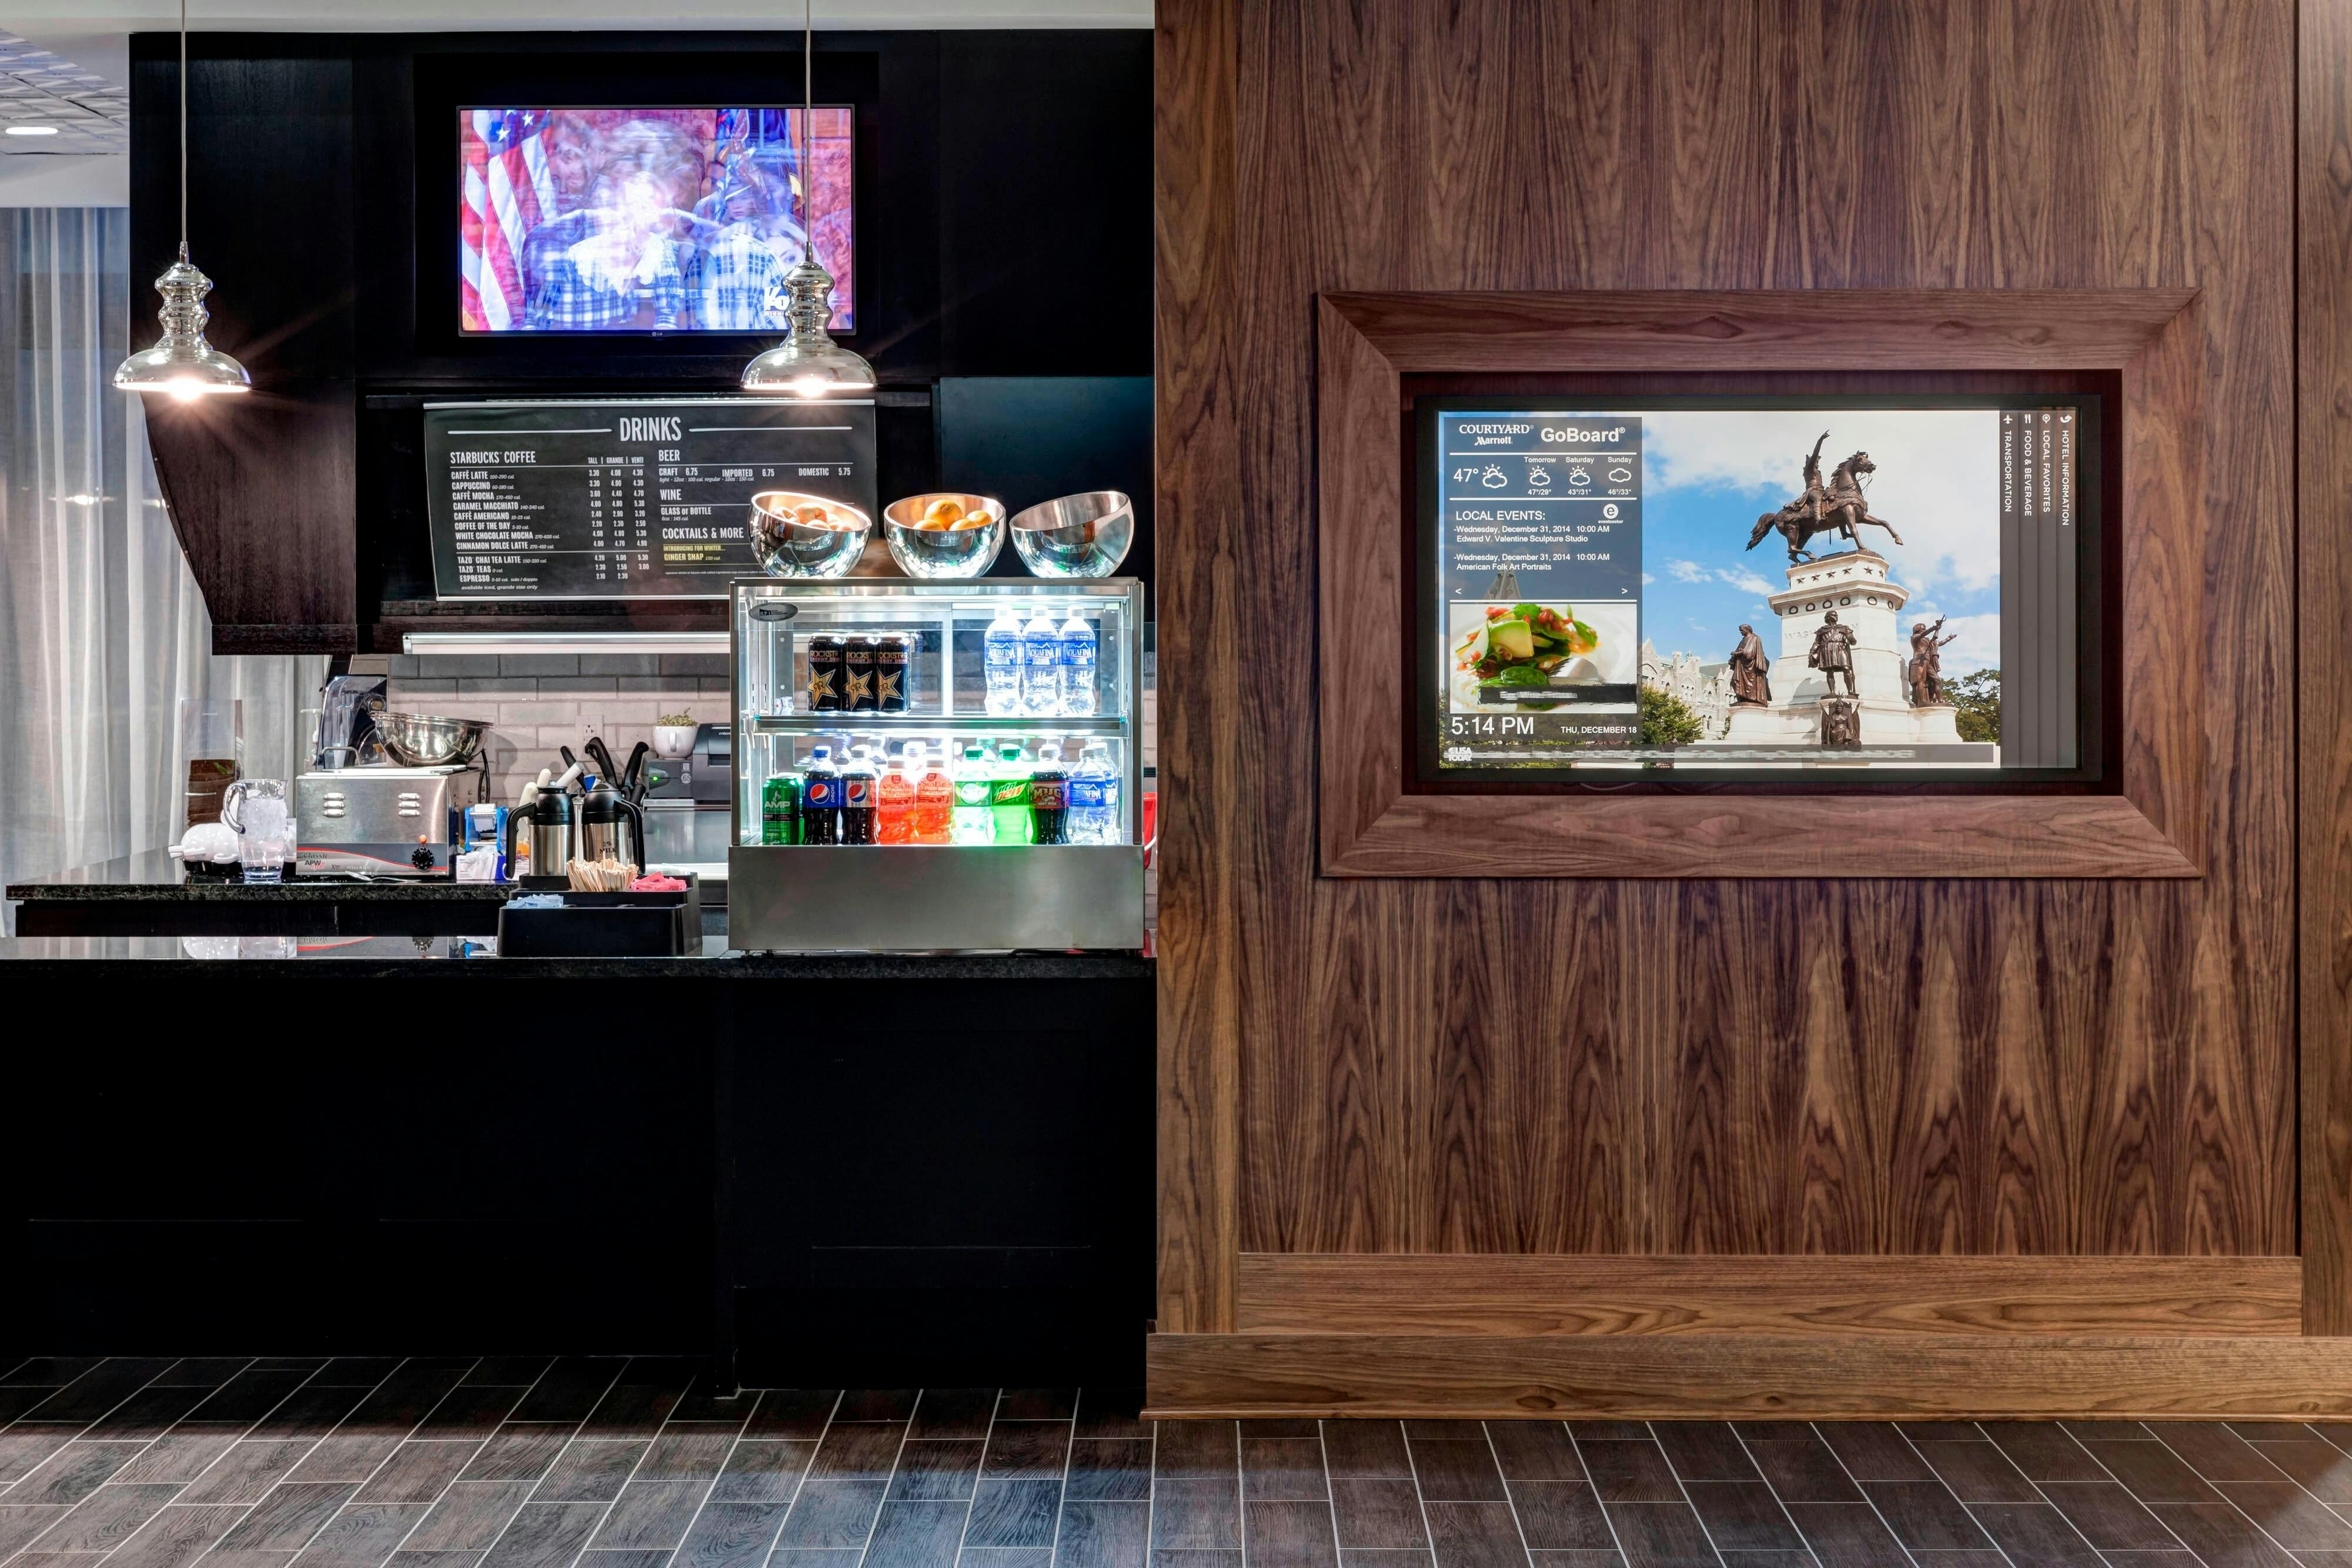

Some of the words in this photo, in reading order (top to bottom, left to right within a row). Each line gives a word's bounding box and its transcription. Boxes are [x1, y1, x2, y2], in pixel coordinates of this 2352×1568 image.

[620, 417, 681, 441] DRINKS
[504, 451, 536, 463] COFFEE
[659, 450, 680, 461] BEER
[451, 470, 469, 480] CAFFÈ
[471, 471, 488, 480] LATTE
[659, 468, 677, 476] CRAFT
[686, 467, 698, 476] 6.75
[762, 469, 774, 477] 6.75
[799, 468, 829, 476] DOMESTIC
[838, 467, 850, 476] 5.75
[1454, 468, 1478, 482] 47°
[452, 482, 490, 490] CAPPUCCINO
[453, 490, 470, 500] CAFFÈ
[472, 492, 495, 500] MOCHA
[660, 489, 682, 500] WINE
[453, 502, 482, 510] CARAMEL
[483, 502, 519, 510] MACCHIATO
[661, 507, 680, 515] GLASS
[690, 507, 711, 515] BOTTLE
[454, 510, 472, 520] CAFFÈ
[474, 512, 509, 520] AMERICANO
[1456, 510, 1494, 520] LOCAL
[1497, 510, 1545, 520] EVENTS:
[455, 522, 476, 530] COFFEE
[477, 522, 485, 530] OF
[455, 531, 475, 540] WHITE
[476, 531, 509, 540] CHOCOLATE
[511, 531, 533, 540] MOCHA
[662, 528, 707, 539] COCKTAILS
[711, 527, 717, 539] &
[720, 527, 744, 539] MORE
[456, 542, 489, 550] CINNAMON
[1451, 717, 1495, 735] 5:14
[1502, 717, 1534, 734] PM
[1034, 788, 1061, 798] MUG
